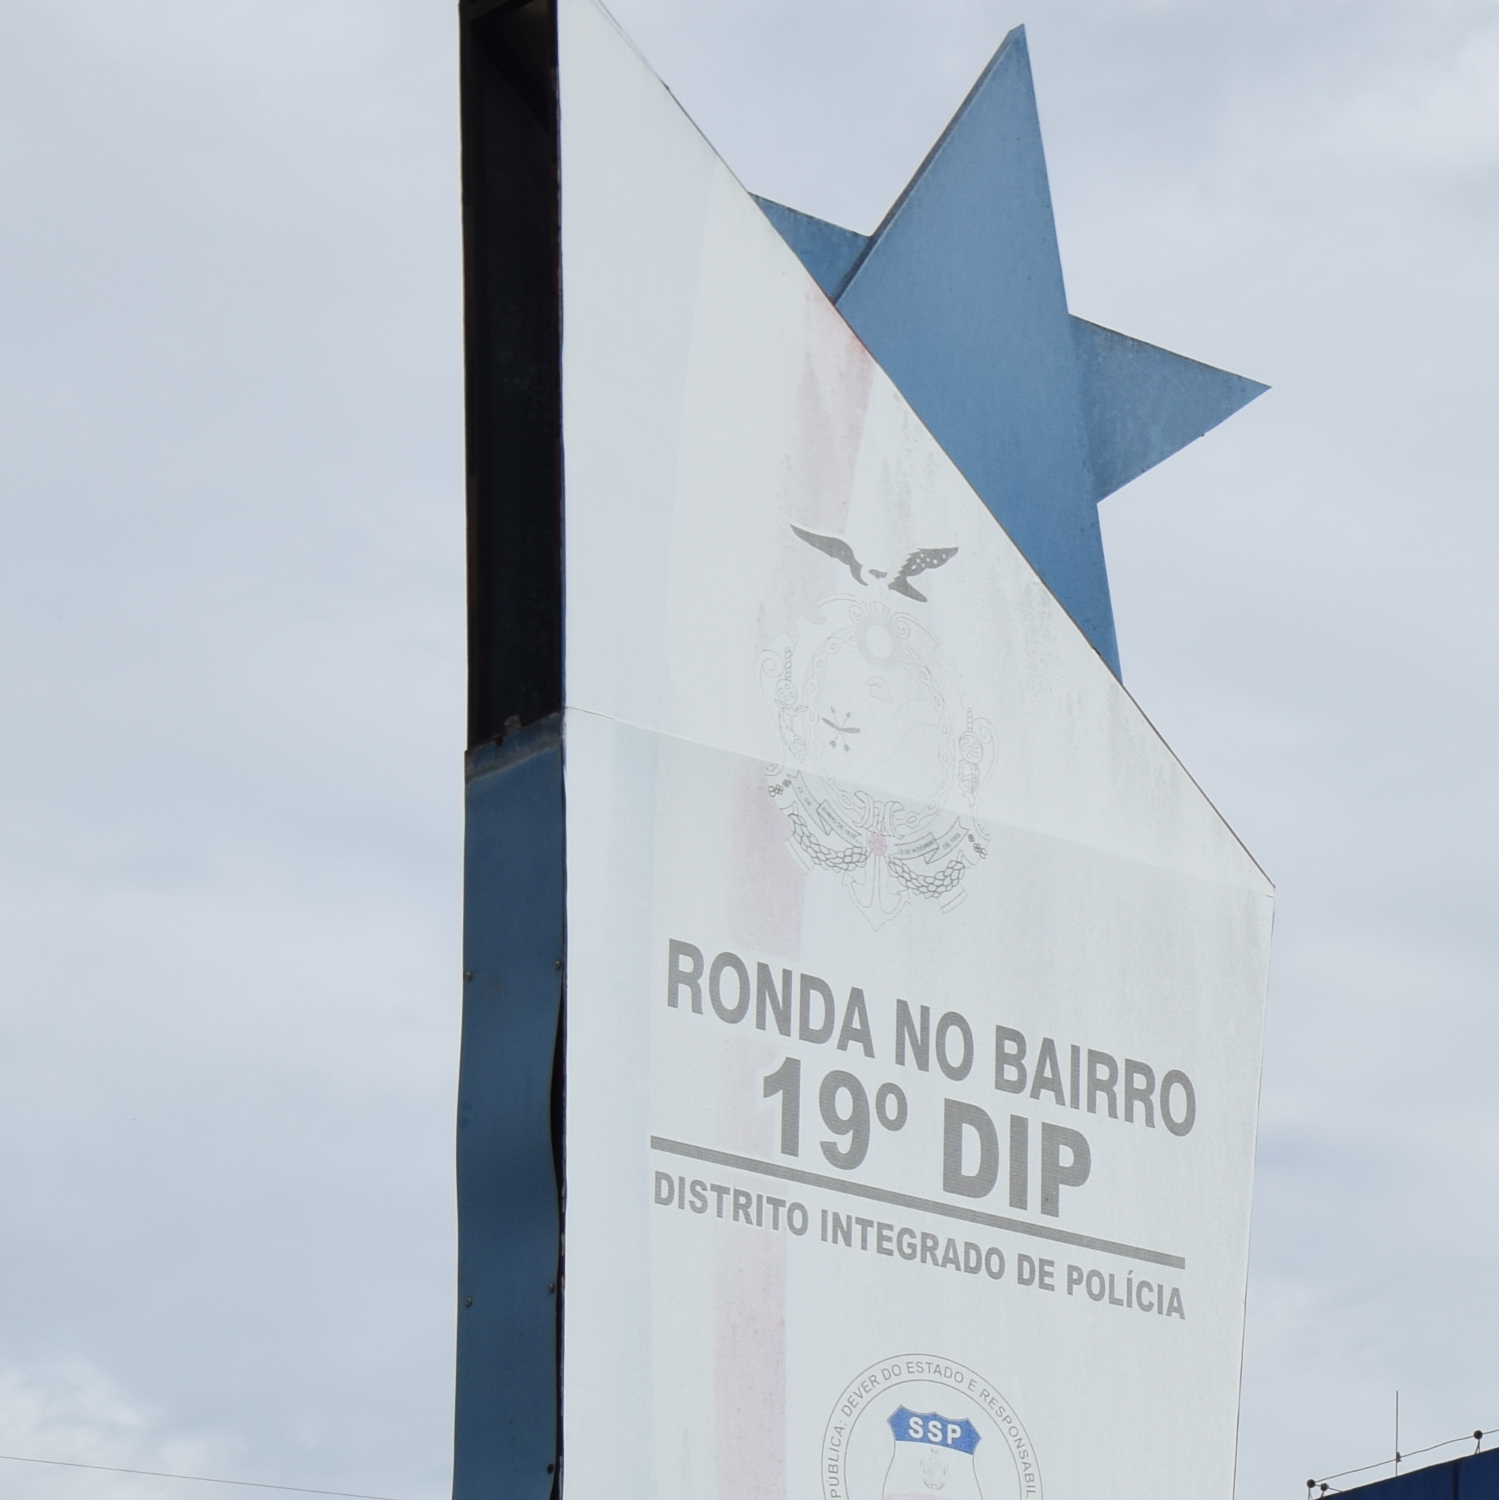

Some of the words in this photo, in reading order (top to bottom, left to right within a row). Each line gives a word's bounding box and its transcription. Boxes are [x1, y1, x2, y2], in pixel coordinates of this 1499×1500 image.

[667, 938, 876, 1059] RONDA
[895, 998, 974, 1082] NO
[995, 1024, 1196, 1137] BAIRRO
[763, 1056, 908, 1171] 19º
[943, 1097, 1091, 1218] DIP
[654, 1170, 809, 1236] DISTRITO
[820, 1209, 1006, 1280] INTEGRADO
[1017, 1253, 1055, 1292] DE
[1066, 1269, 1186, 1320] POLÍCIA
[841, 1374, 880, 1418] DEVER
[881, 1364, 902, 1381] DO
[906, 1361, 964, 1384] ESTADO
[967, 1379, 978, 1393] E
[908, 1416, 962, 1445] SSP
